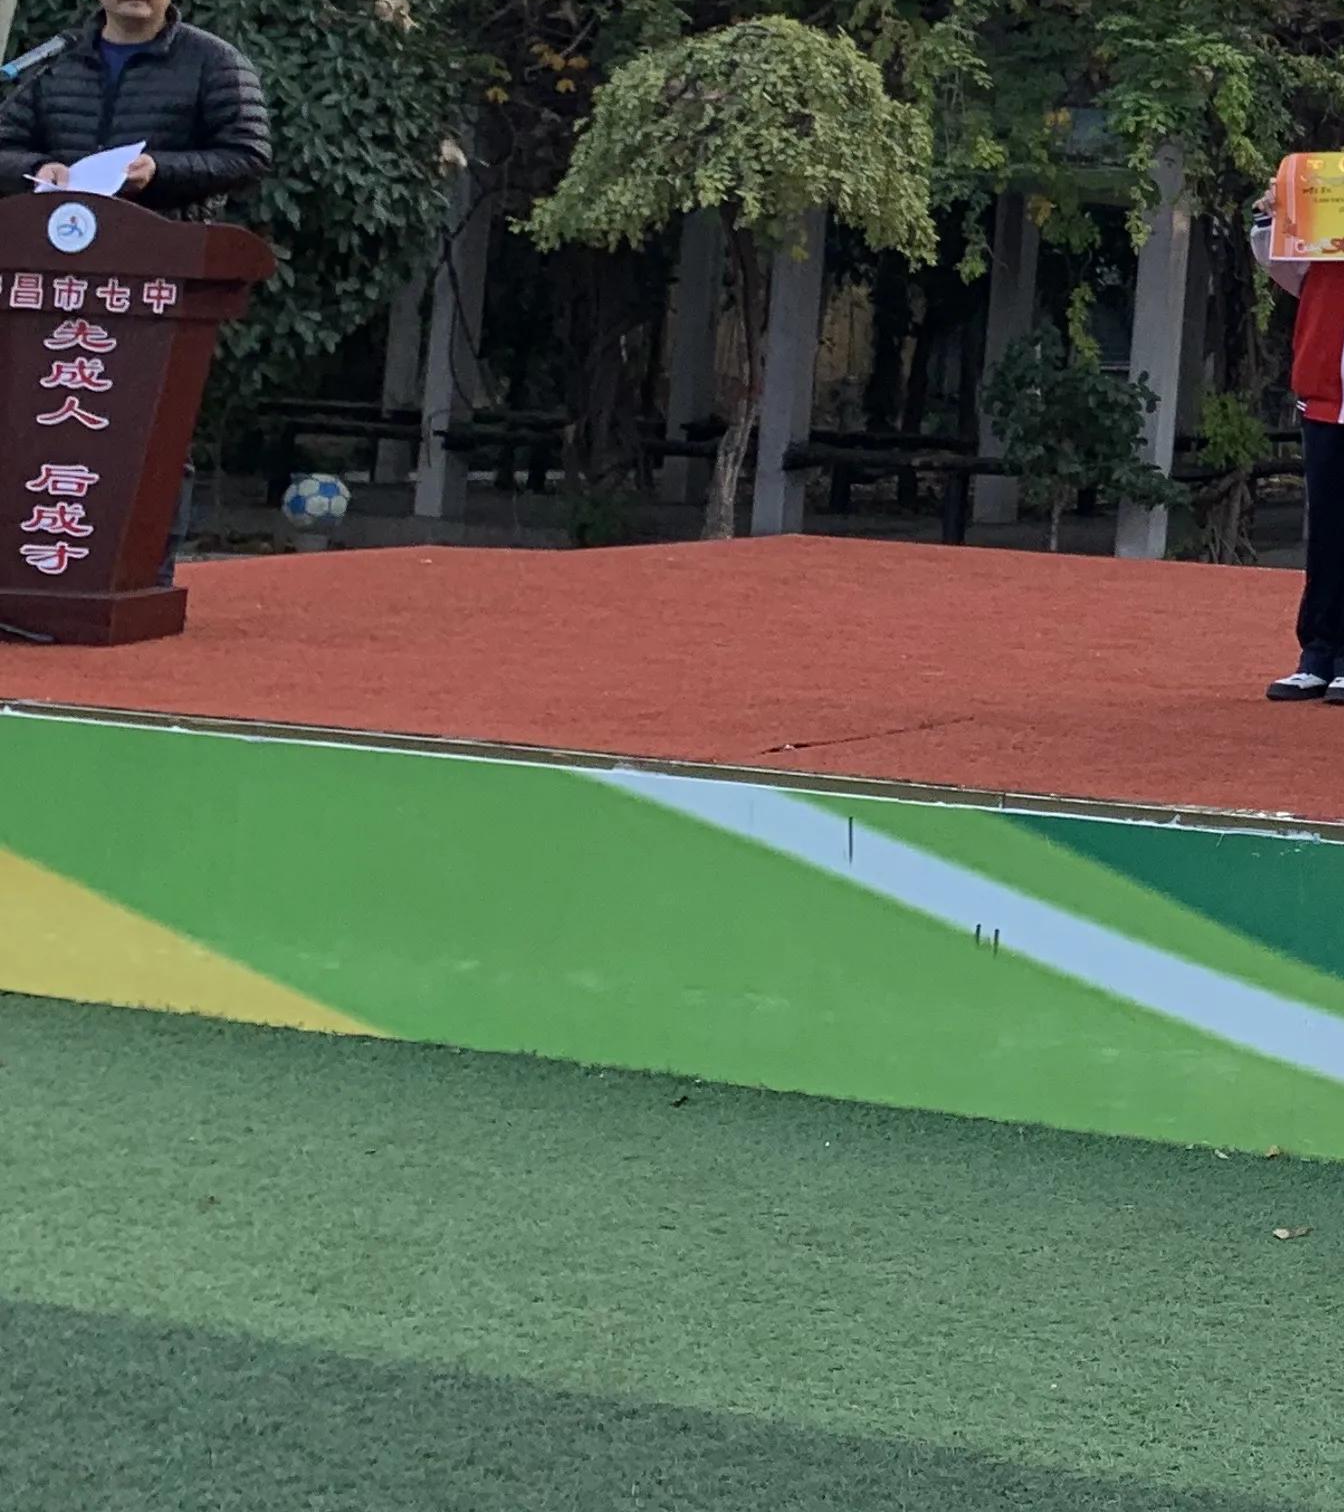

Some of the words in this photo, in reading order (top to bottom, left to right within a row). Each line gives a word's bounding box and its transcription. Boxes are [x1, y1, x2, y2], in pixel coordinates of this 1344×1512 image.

[0, 272, 177, 315] 昌市七中
[36, 319, 117, 431] 先成人
[19, 463, 100, 575] 后成才
